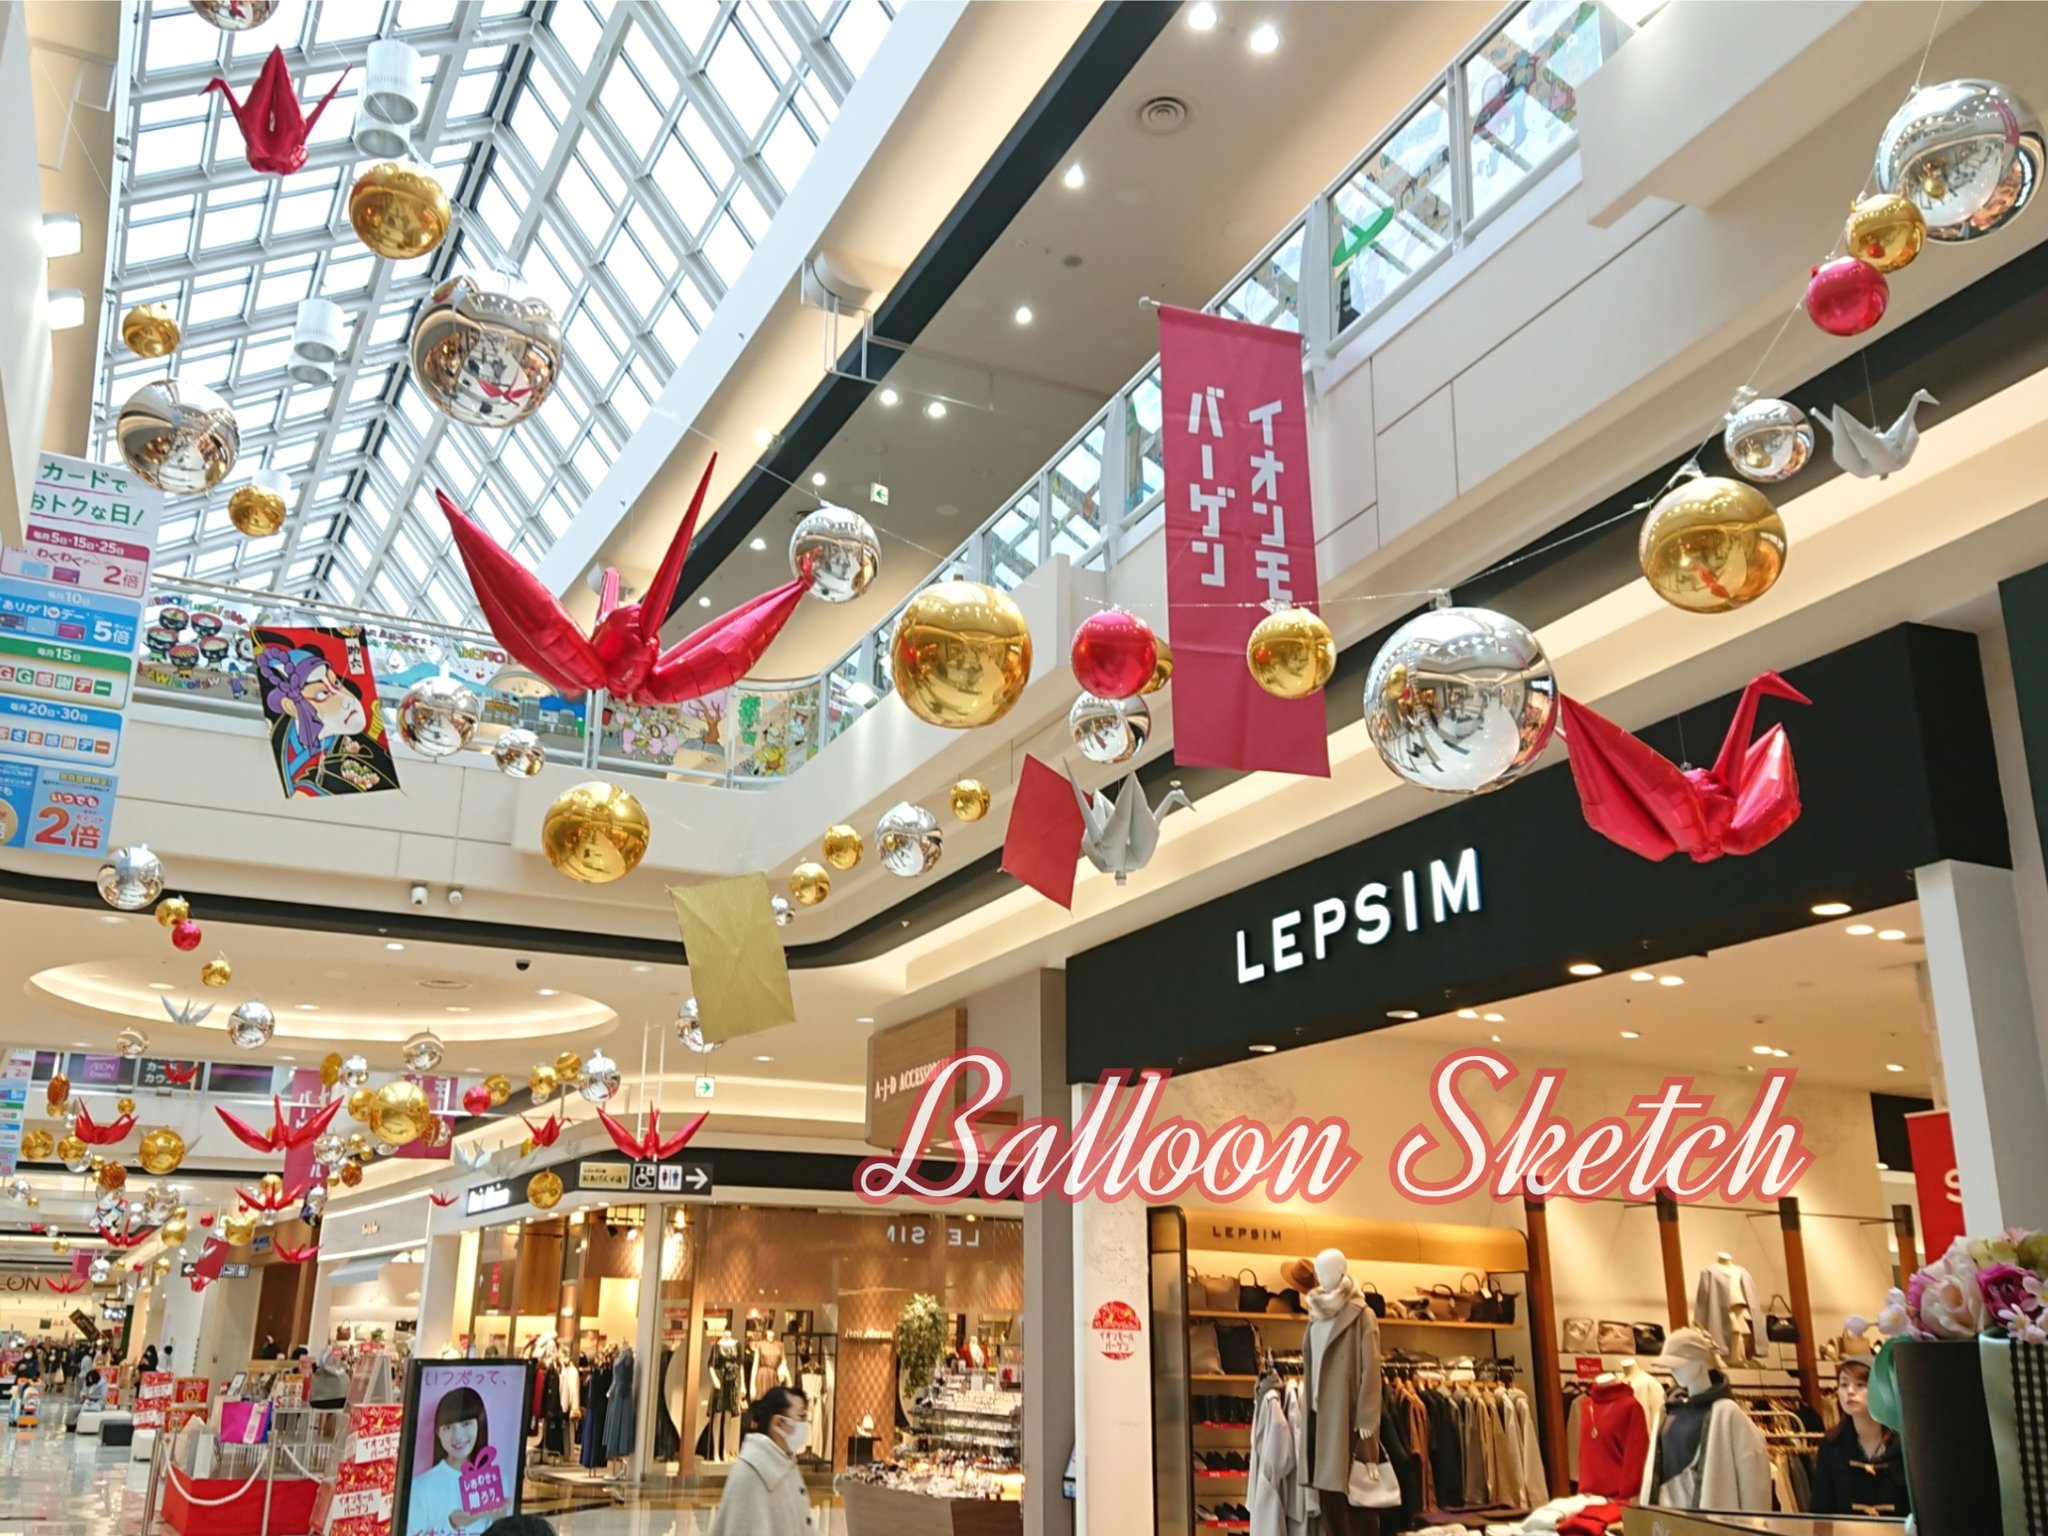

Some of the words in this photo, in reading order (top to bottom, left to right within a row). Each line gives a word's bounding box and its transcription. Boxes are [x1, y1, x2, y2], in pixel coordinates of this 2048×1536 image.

[42, 462, 128, 493] カードで
[1188, 386, 1234, 587] バーゲン
[50, 790, 98, 808] いつでも
[35, 806, 101, 849] 2倍
[1236, 846, 1482, 985] LEPSIM
[1212, 1225, 1283, 1243] LEPSIM
